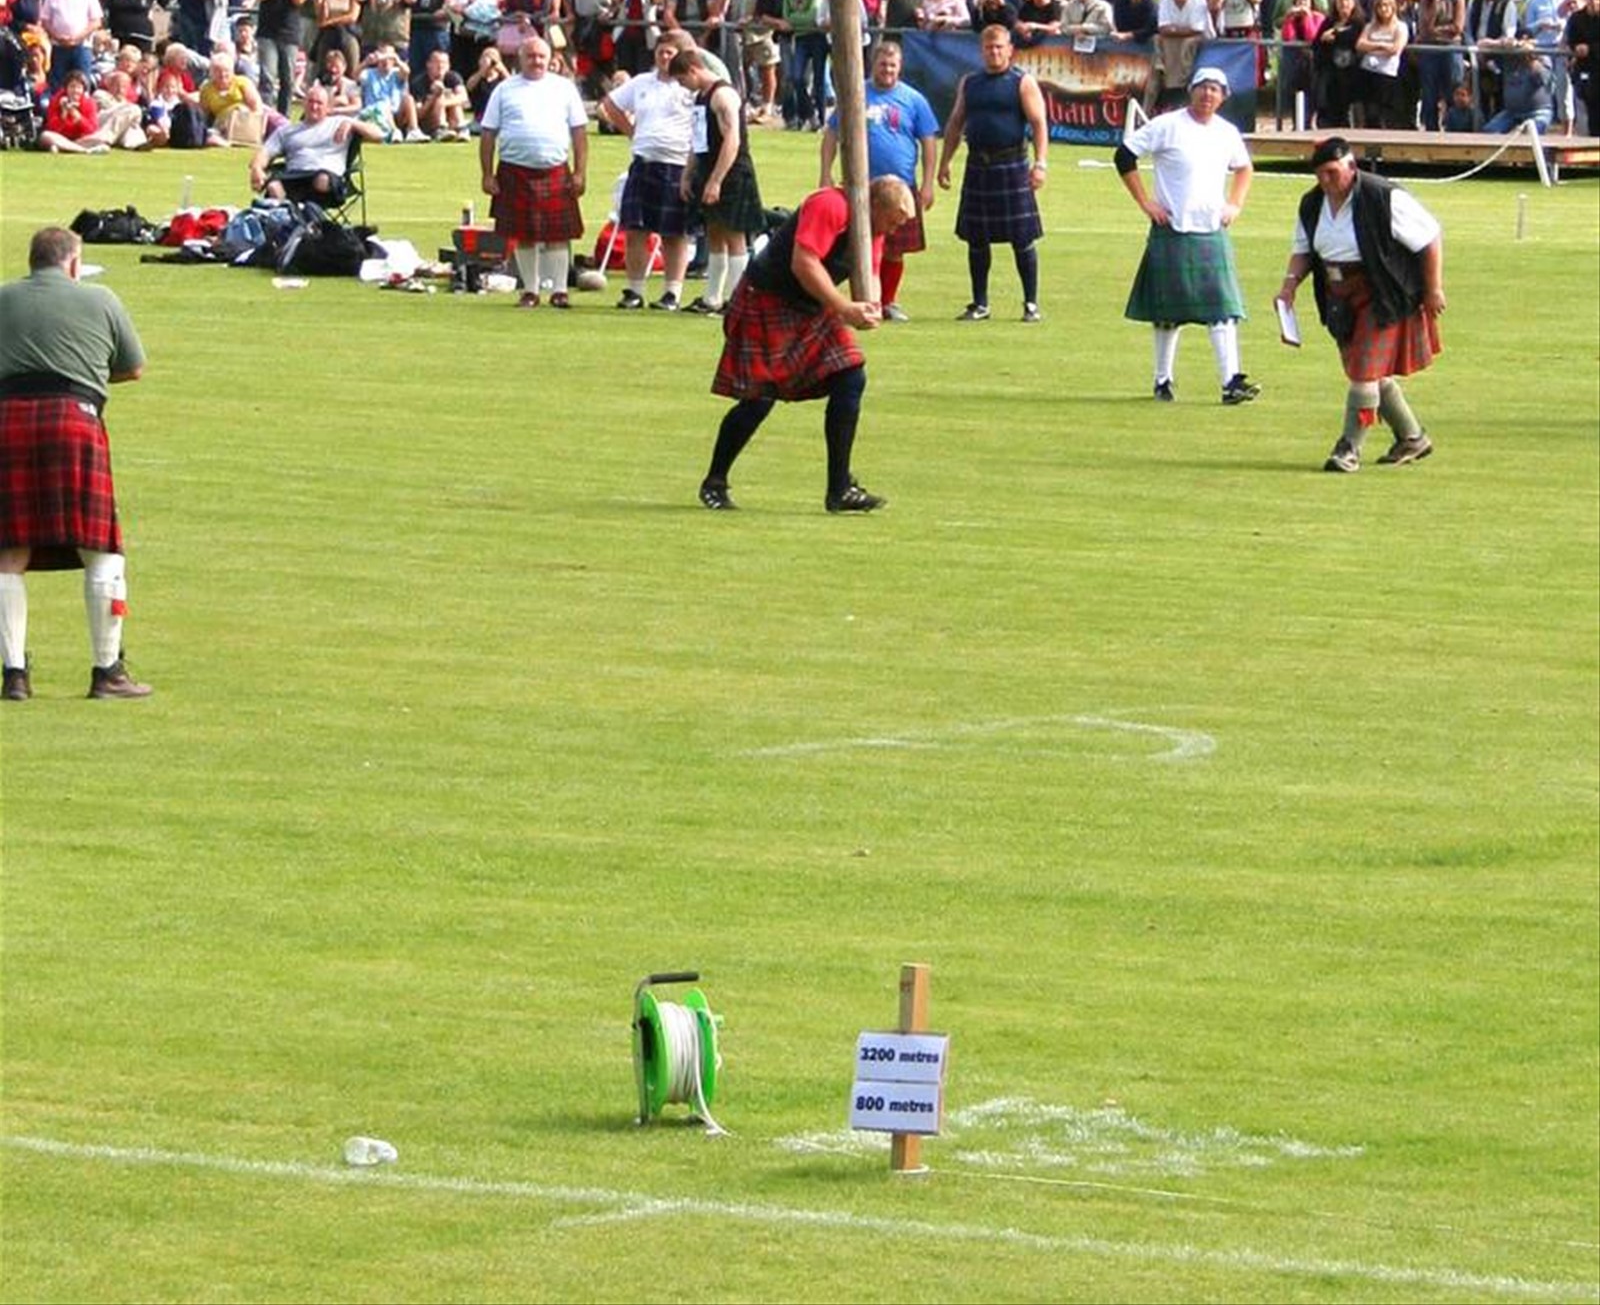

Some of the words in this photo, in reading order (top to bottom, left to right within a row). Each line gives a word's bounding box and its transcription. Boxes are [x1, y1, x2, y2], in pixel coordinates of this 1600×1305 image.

[860, 1048, 895, 1062] 3200
[899, 1050, 939, 1064] metres
[856, 1096, 885, 1112] 800
[889, 1099, 934, 1113] metres
